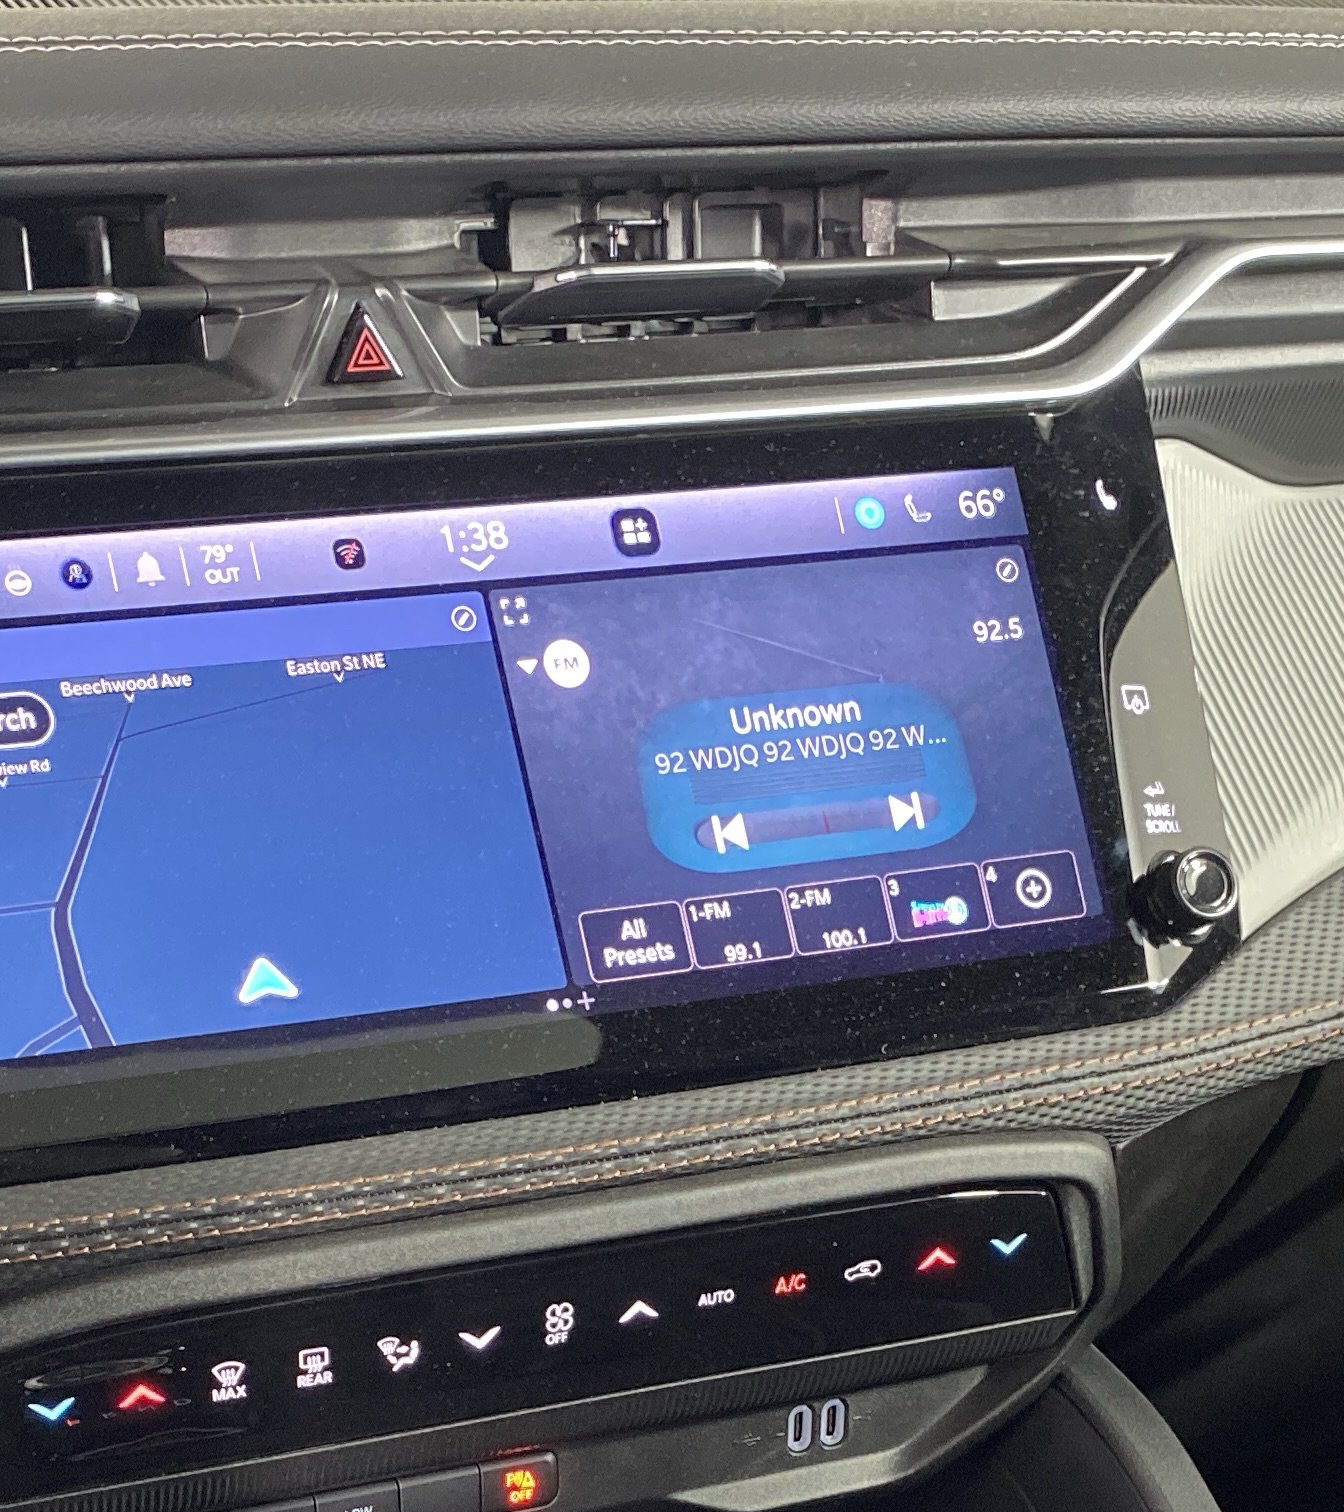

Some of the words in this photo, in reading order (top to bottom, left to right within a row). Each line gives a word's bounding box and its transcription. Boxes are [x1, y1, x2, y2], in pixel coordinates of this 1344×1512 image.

[958, 488, 1006, 519] 66°
[440, 520, 508, 553] 1:38
[200, 544, 234, 564] 79°
[204, 567, 240, 585] OUT
[973, 617, 1024, 643] 92.5
[286, 657, 342, 677] Easton
[342, 655, 362, 673] St
[362, 652, 387, 671] NE
[553, 656, 580, 671] FM
[60, 673, 158, 698] Beechwood
[161, 672, 193, 691] Ave
[729, 700, 862, 735] Unknown
[654, 751, 687, 775] 92
[688, 743, 760, 772] WDJQ
[763, 740, 795, 763] 92
[796, 732, 865, 760] WDJQ
[868, 728, 899, 751] 92
[26, 758, 51, 775] Rd
[1146, 819, 1182, 834] SCROLL
[985, 866, 998, 883] 4
[887, 879, 900, 896] 3
[788, 888, 832, 910] 2-FM
[689, 900, 732, 922] 1-FM
[621, 917, 648, 941] All
[822, 926, 867, 949] 100.1
[603, 942, 675, 969] Presets
[724, 941, 762, 962] 99.1
[774, 1273, 807, 1295] A/C
[697, 1289, 735, 1307] AUTO
[545, 1332, 568, 1346] OFF
[297, 1370, 333, 1388] REAR
[212, 1384, 247, 1401] MAX
[509, 1489, 533, 1503] OFF
